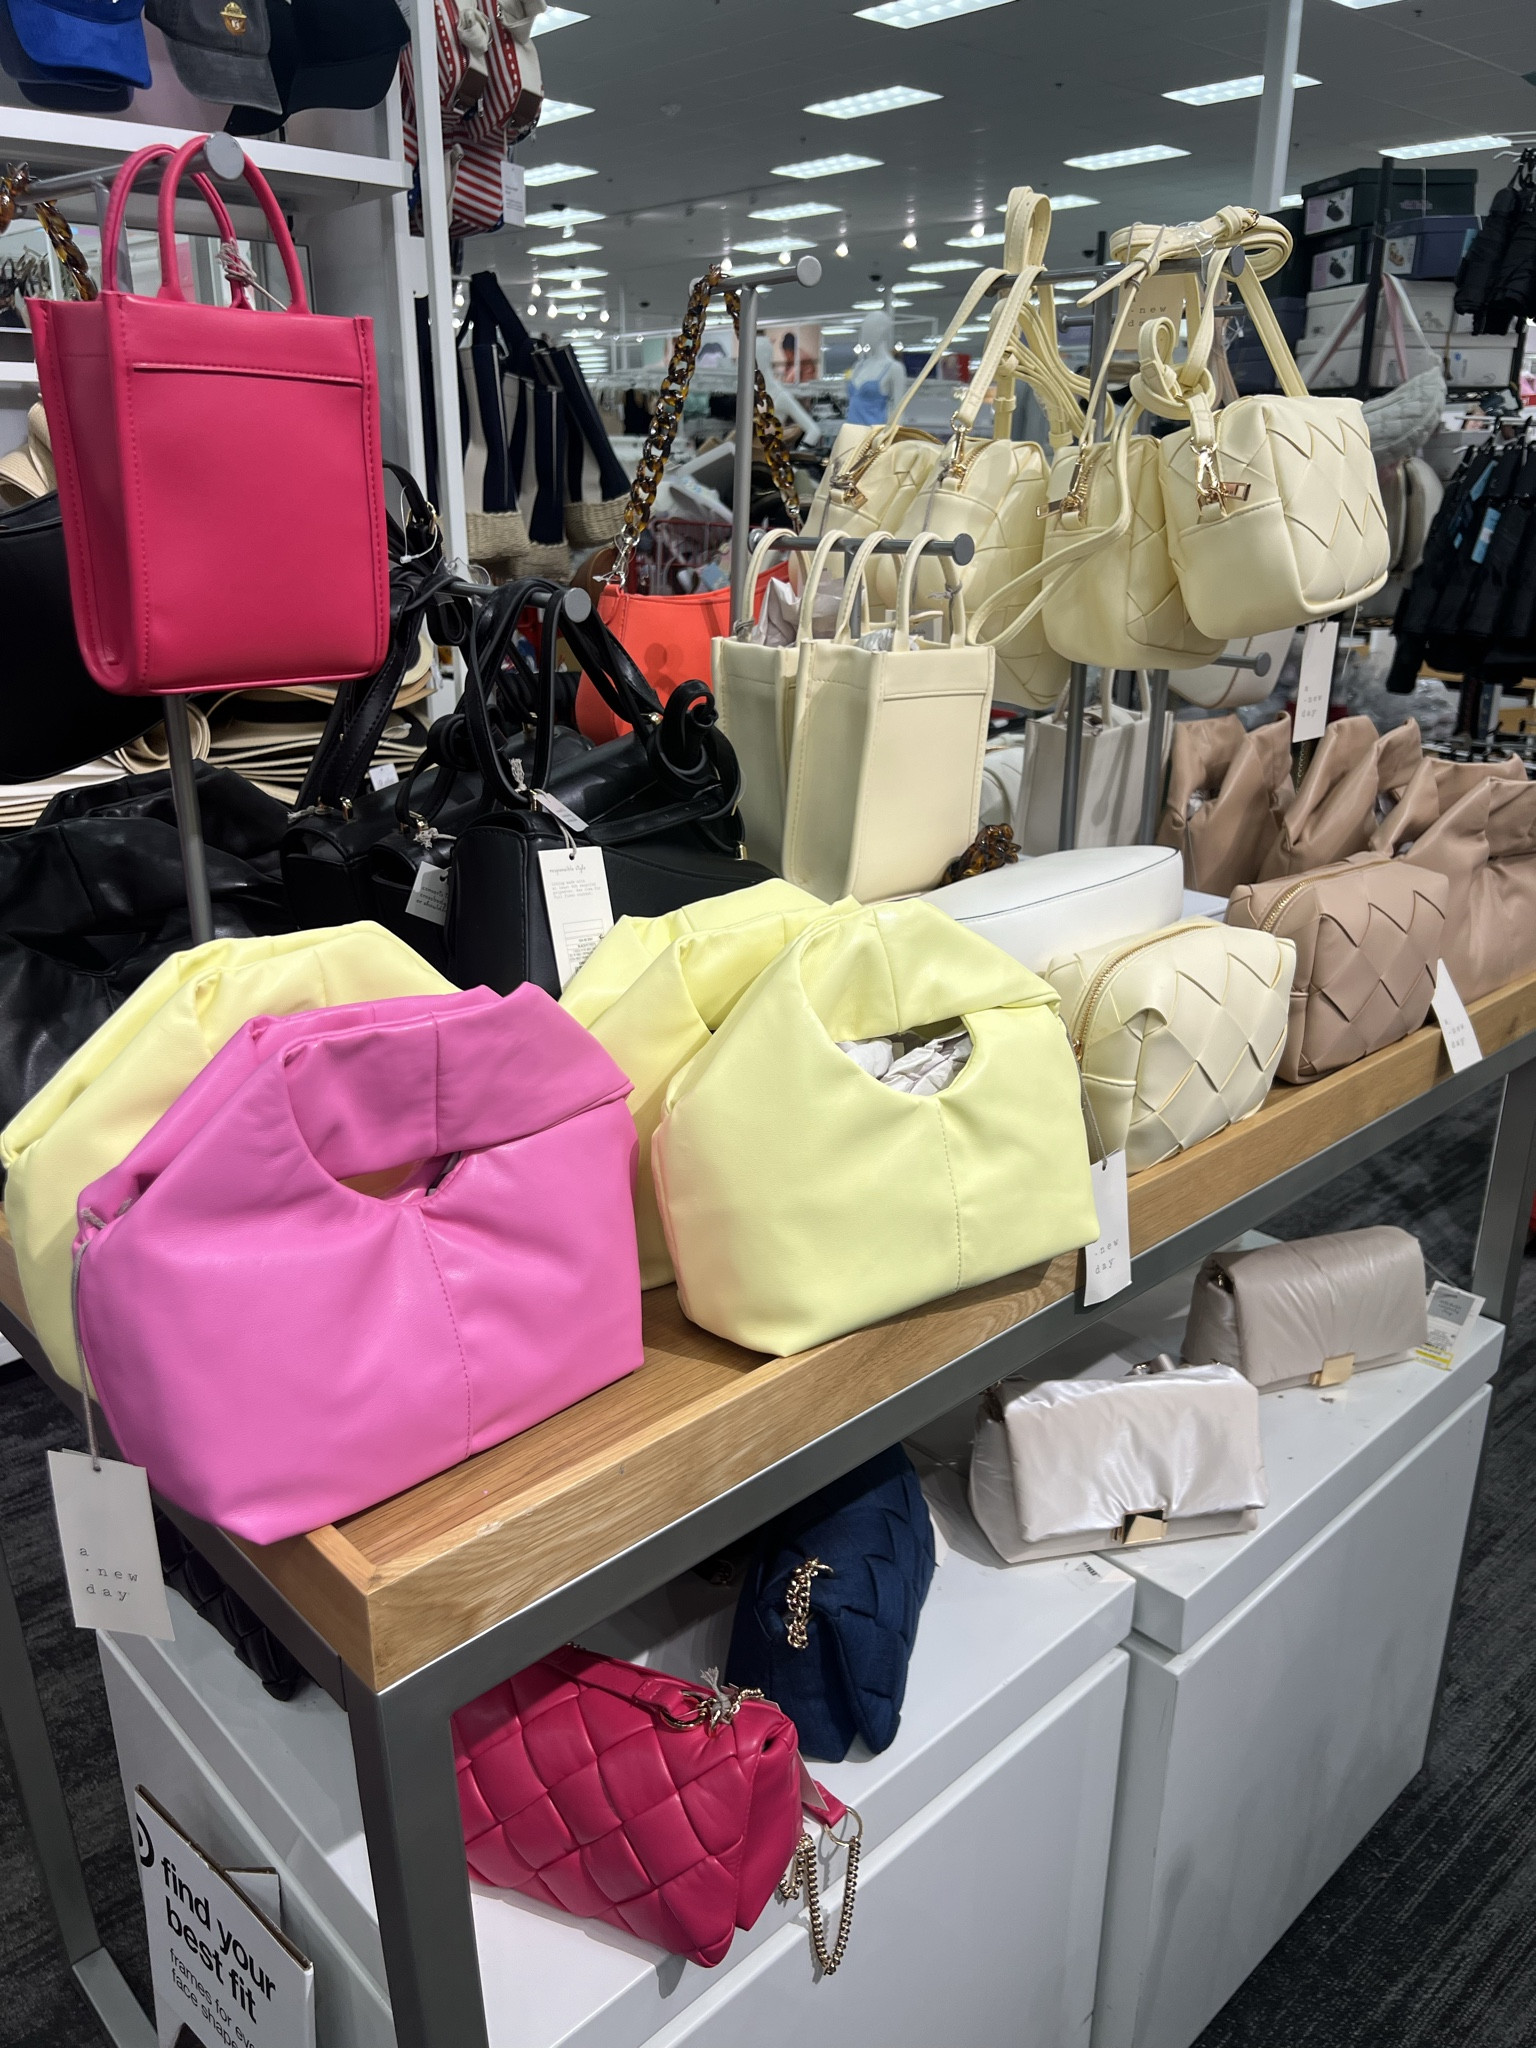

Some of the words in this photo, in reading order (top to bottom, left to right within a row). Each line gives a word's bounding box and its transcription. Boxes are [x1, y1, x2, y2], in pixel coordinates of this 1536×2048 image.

[79, 1547, 89, 1557] a
[86, 1584, 128, 1601] day
[161, 1857, 211, 1931] find
[217, 1919, 276, 2001] your
[166, 1896, 224, 1985] best
[229, 1969, 257, 2024] fit
[170, 1948, 212, 2005] frames
[215, 1999, 232, 2026] for
[172, 1968, 198, 2007] face
